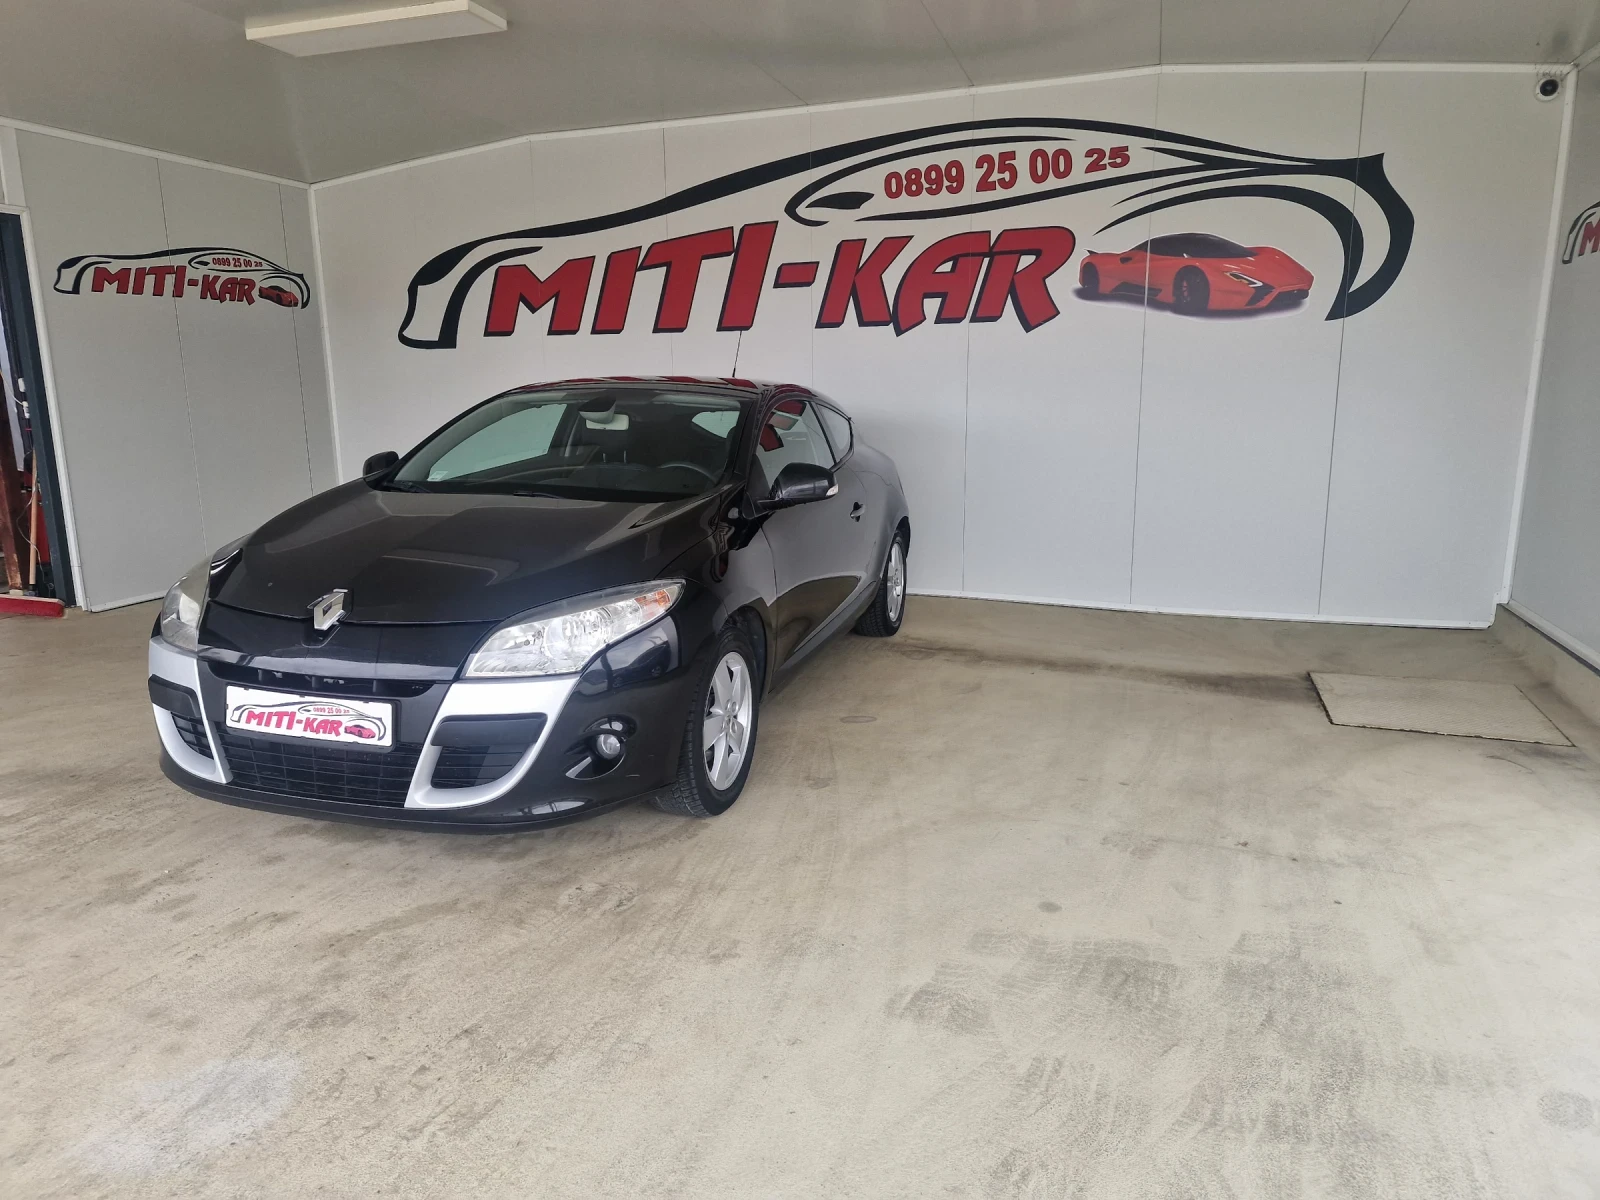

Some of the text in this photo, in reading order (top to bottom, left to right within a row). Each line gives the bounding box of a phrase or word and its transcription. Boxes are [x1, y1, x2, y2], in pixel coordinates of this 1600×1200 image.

[884, 145, 1131, 200] 0899 25 00 25
[211, 257, 231, 267] 0899
[232, 257, 242, 268] 25
[243, 259, 253, 268] 00
[483, 220, 1076, 337] MITI-KAR
[91, 265, 256, 305] MITI-KAR
[245, 711, 343, 737] MITI-KAR
